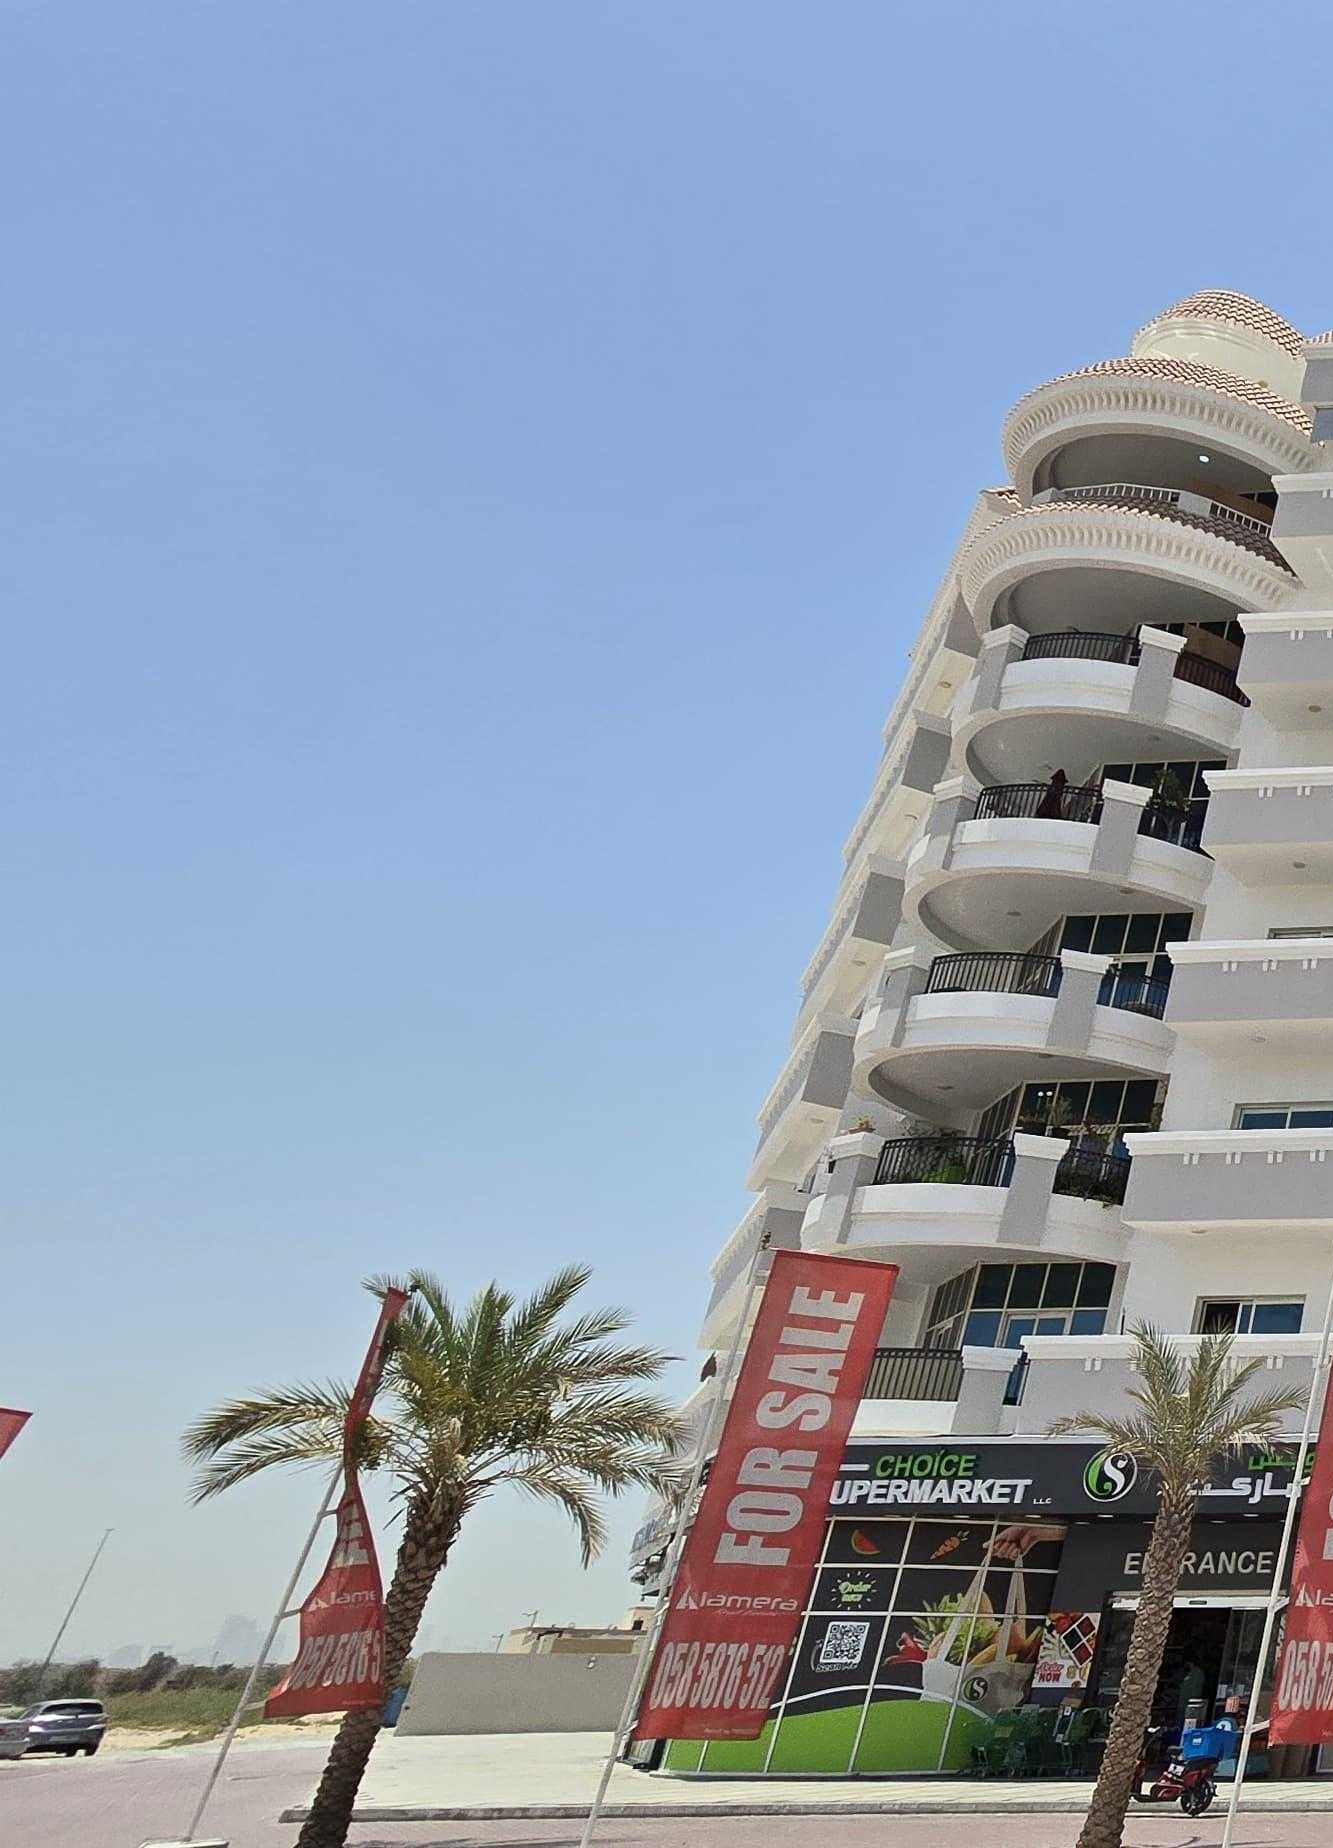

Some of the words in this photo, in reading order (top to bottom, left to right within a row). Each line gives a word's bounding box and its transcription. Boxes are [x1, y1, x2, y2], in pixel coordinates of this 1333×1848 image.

[756, 1286, 865, 1431] SALE
[713, 1447, 819, 1566] FOR
[829, 1479, 1033, 1506] UPERMARKET
[1123, 1551, 1274, 1575] ERANCE
[675, 1583, 798, 1611] Alamera
[651, 1641, 699, 1710] 058
[690, 1642, 749, 1710] 5876
[741, 1644, 785, 1710] 512
[1038, 1672, 1062, 1683] NOW
[1278, 1640, 1321, 1711] 058
